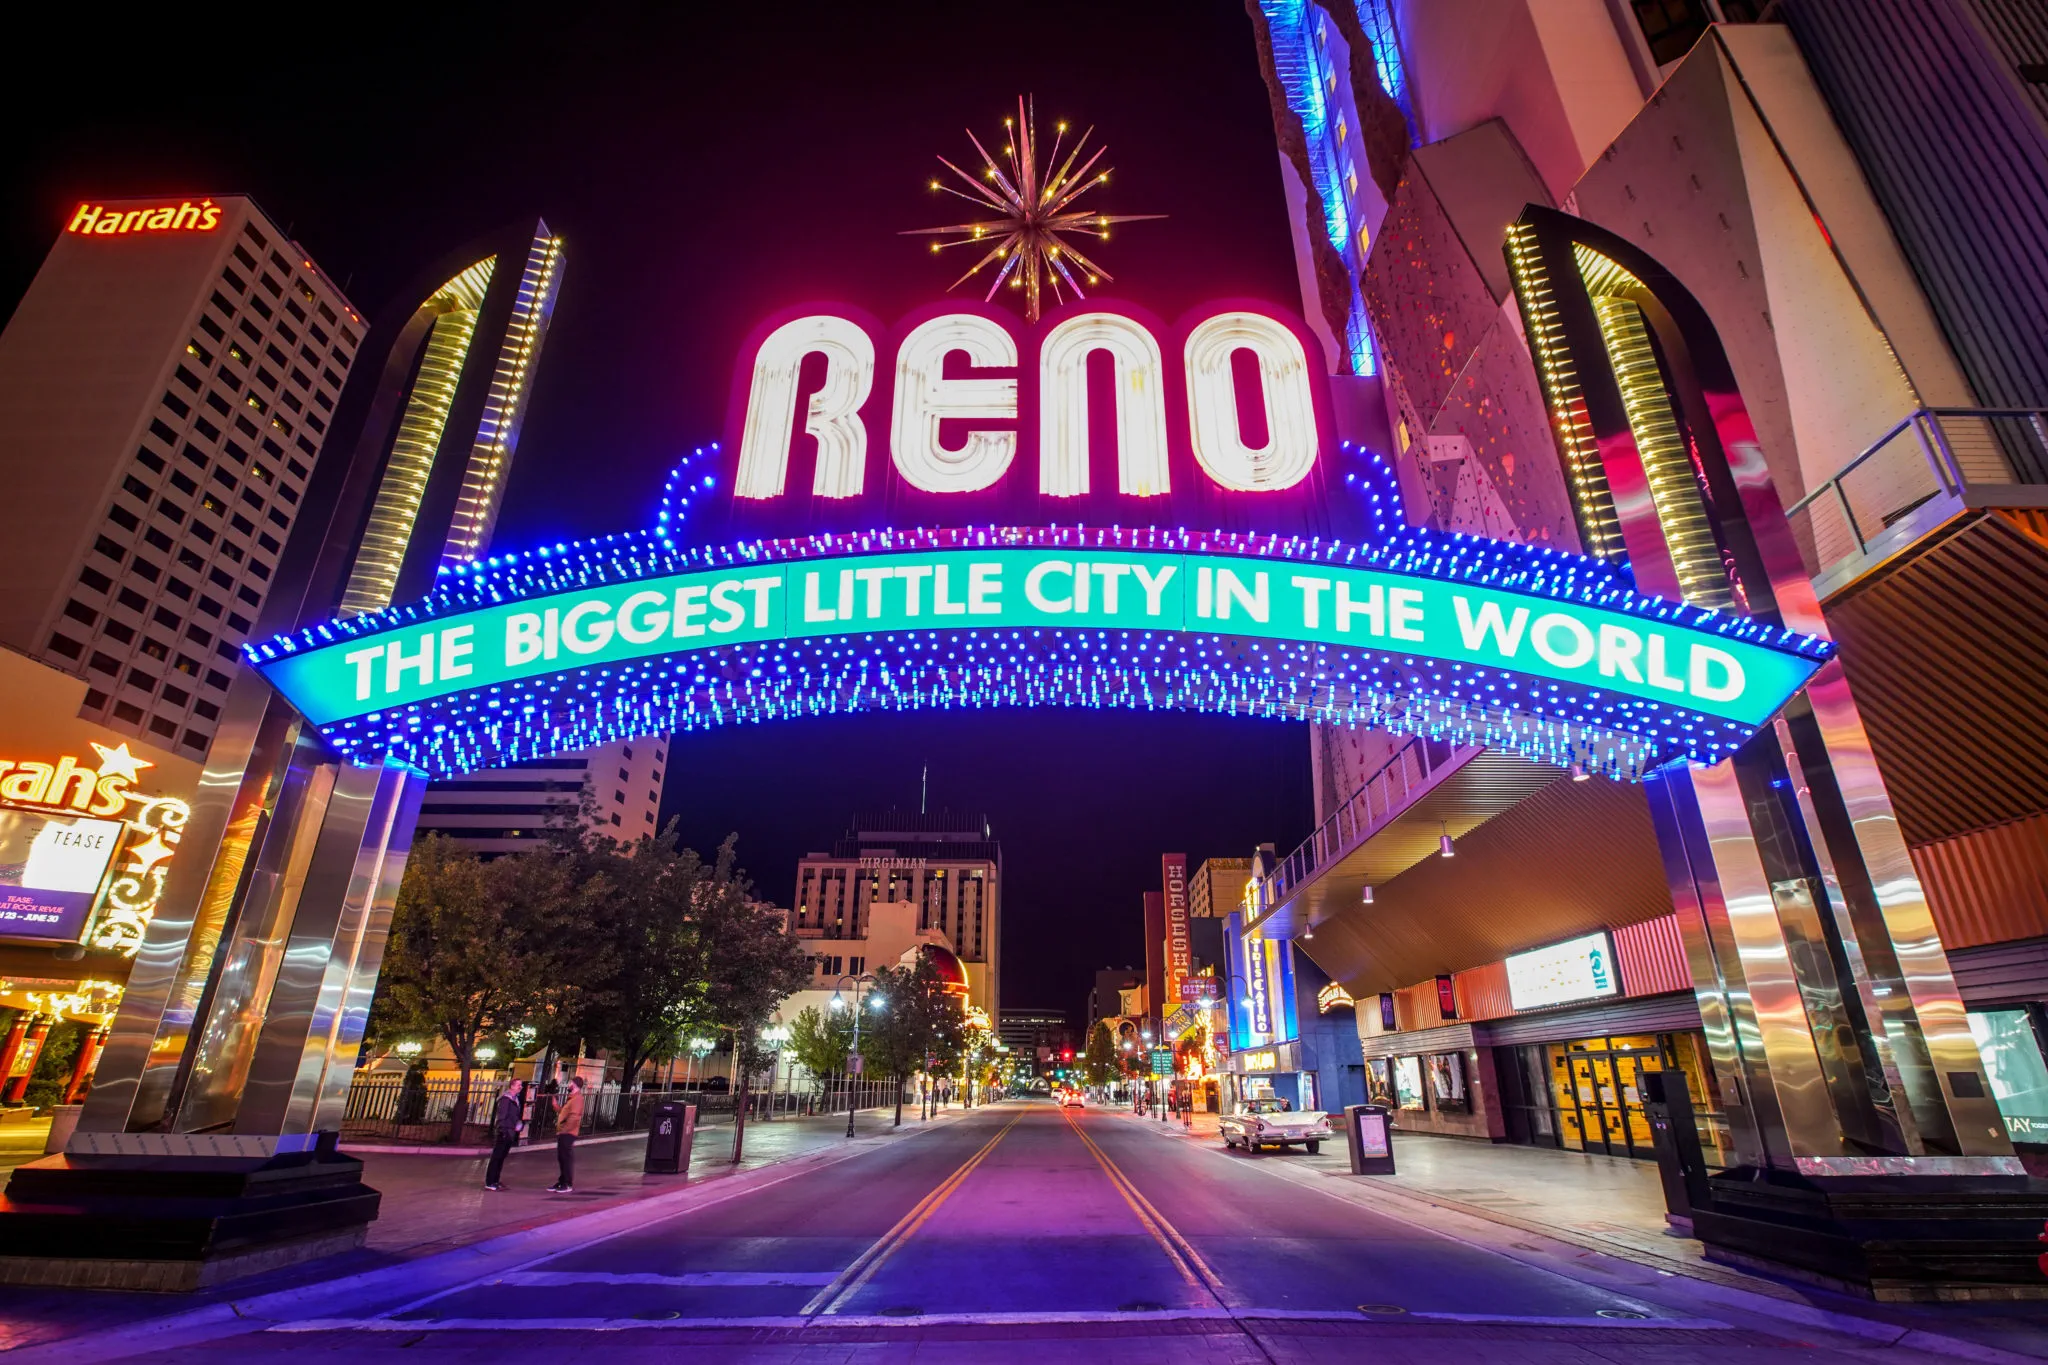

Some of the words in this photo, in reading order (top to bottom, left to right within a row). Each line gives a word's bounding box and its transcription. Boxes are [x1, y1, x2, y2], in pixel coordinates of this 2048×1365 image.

[68, 199, 221, 234] Harrah's
[734, 312, 1319, 499] RENO
[345, 625, 474, 701] THE
[505, 577, 781, 667] BIGGEST
[804, 563, 1002, 622] LITTLE
[1024, 560, 1177, 615] CITY
[1197, 567, 1269, 623] IN
[1292, 576, 1424, 642] THE
[1453, 596, 1746, 702] WORLD
[54, 831, 104, 849] TEASE
[859, 857, 927, 869] VIRGINIAN
[4, 911, 17, 920] 23
[23, 914, 47, 922] JUNE
[47, 915, 59, 923] 30
[12, 903, 38, 912] ROCK
[39, 906, 64, 914] REVUE
[1253, 978, 1268, 1031] CASINO
